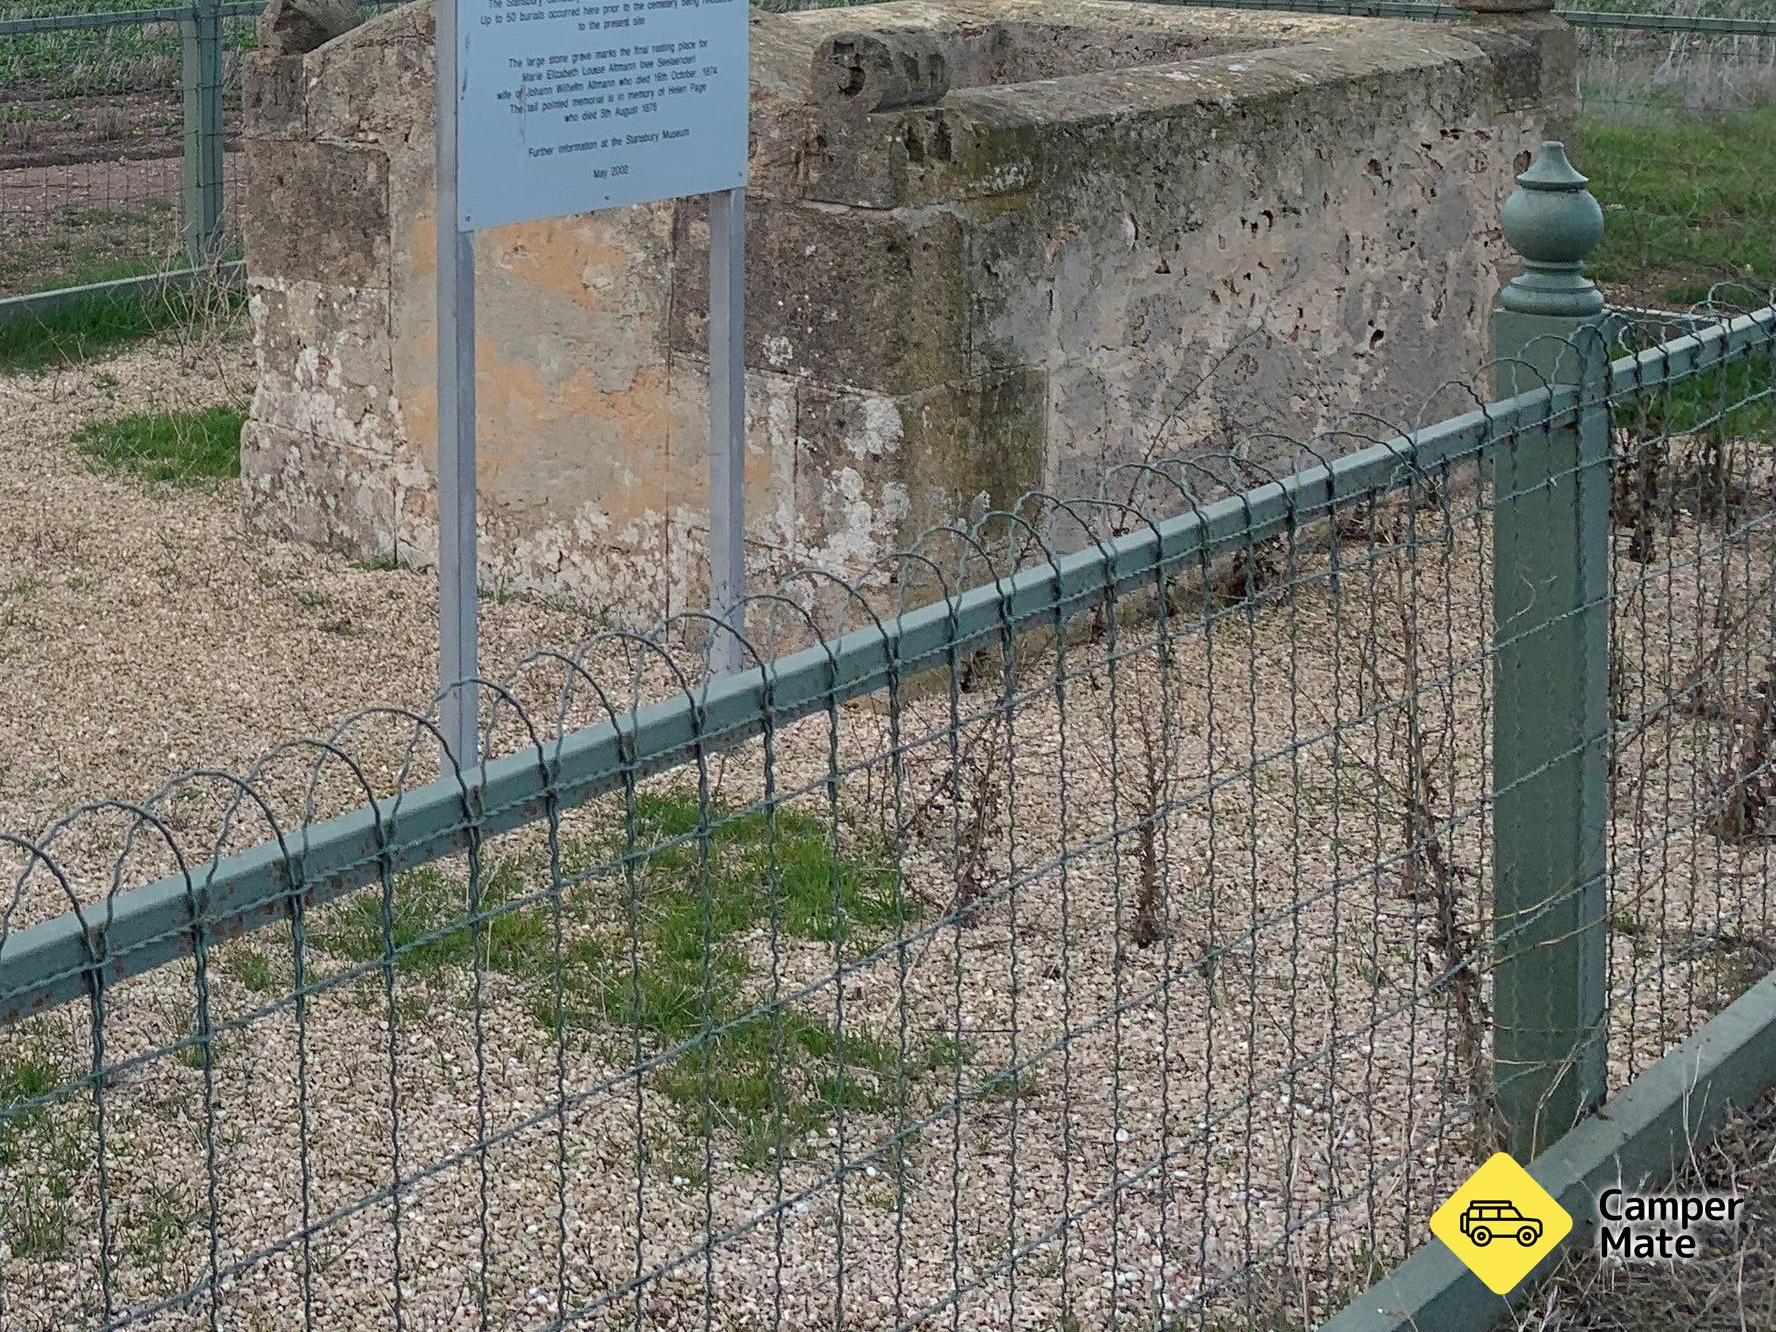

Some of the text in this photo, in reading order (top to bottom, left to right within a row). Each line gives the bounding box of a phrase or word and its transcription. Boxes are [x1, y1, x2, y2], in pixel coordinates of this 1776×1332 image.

[480, 16, 491, 25] Up
[495, 15, 503, 23] to
[506, 11, 516, 22] 50
[519, 10, 544, 21] burials
[548, 8, 580, 19] occurred
[583, 6, 599, 15] here
[602, 4, 619, 14] prior
[623, 3, 630, 11] to
[633, 2, 644, 11] the
[647, 0, 677, 10] cemetery
[578, 17, 644, 30] to the present site
[508, 39, 707, 68] The large stone grave marks the final resting place for
[521, 72, 543, 82] Marie
[546, 67, 578, 80] Elizabeth
[582, 65, 605, 76] Louise
[497, 90, 511, 99] wife
[515, 88, 524, 98] of
[525, 86, 552, 97] Johann
[555, 82, 583, 93] Wilhelm
[618, 77, 632, 86] who
[635, 75, 650, 84] died
[509, 104, 523, 113] The
[527, 102, 538, 112] tall
[542, 99, 568, 111] pointed
[572, 95, 604, 106] memorial
[608, 94, 614, 102] is
[627, 90, 654, 99] memory
[657, 86, 665, 96] of
[564, 113, 578, 122] who
[581, 111, 597, 121] died
[615, 106, 638, 117] August
[528, 128, 689, 157] Further information at the Stansbury Museum
[593, 169, 607, 179] May
